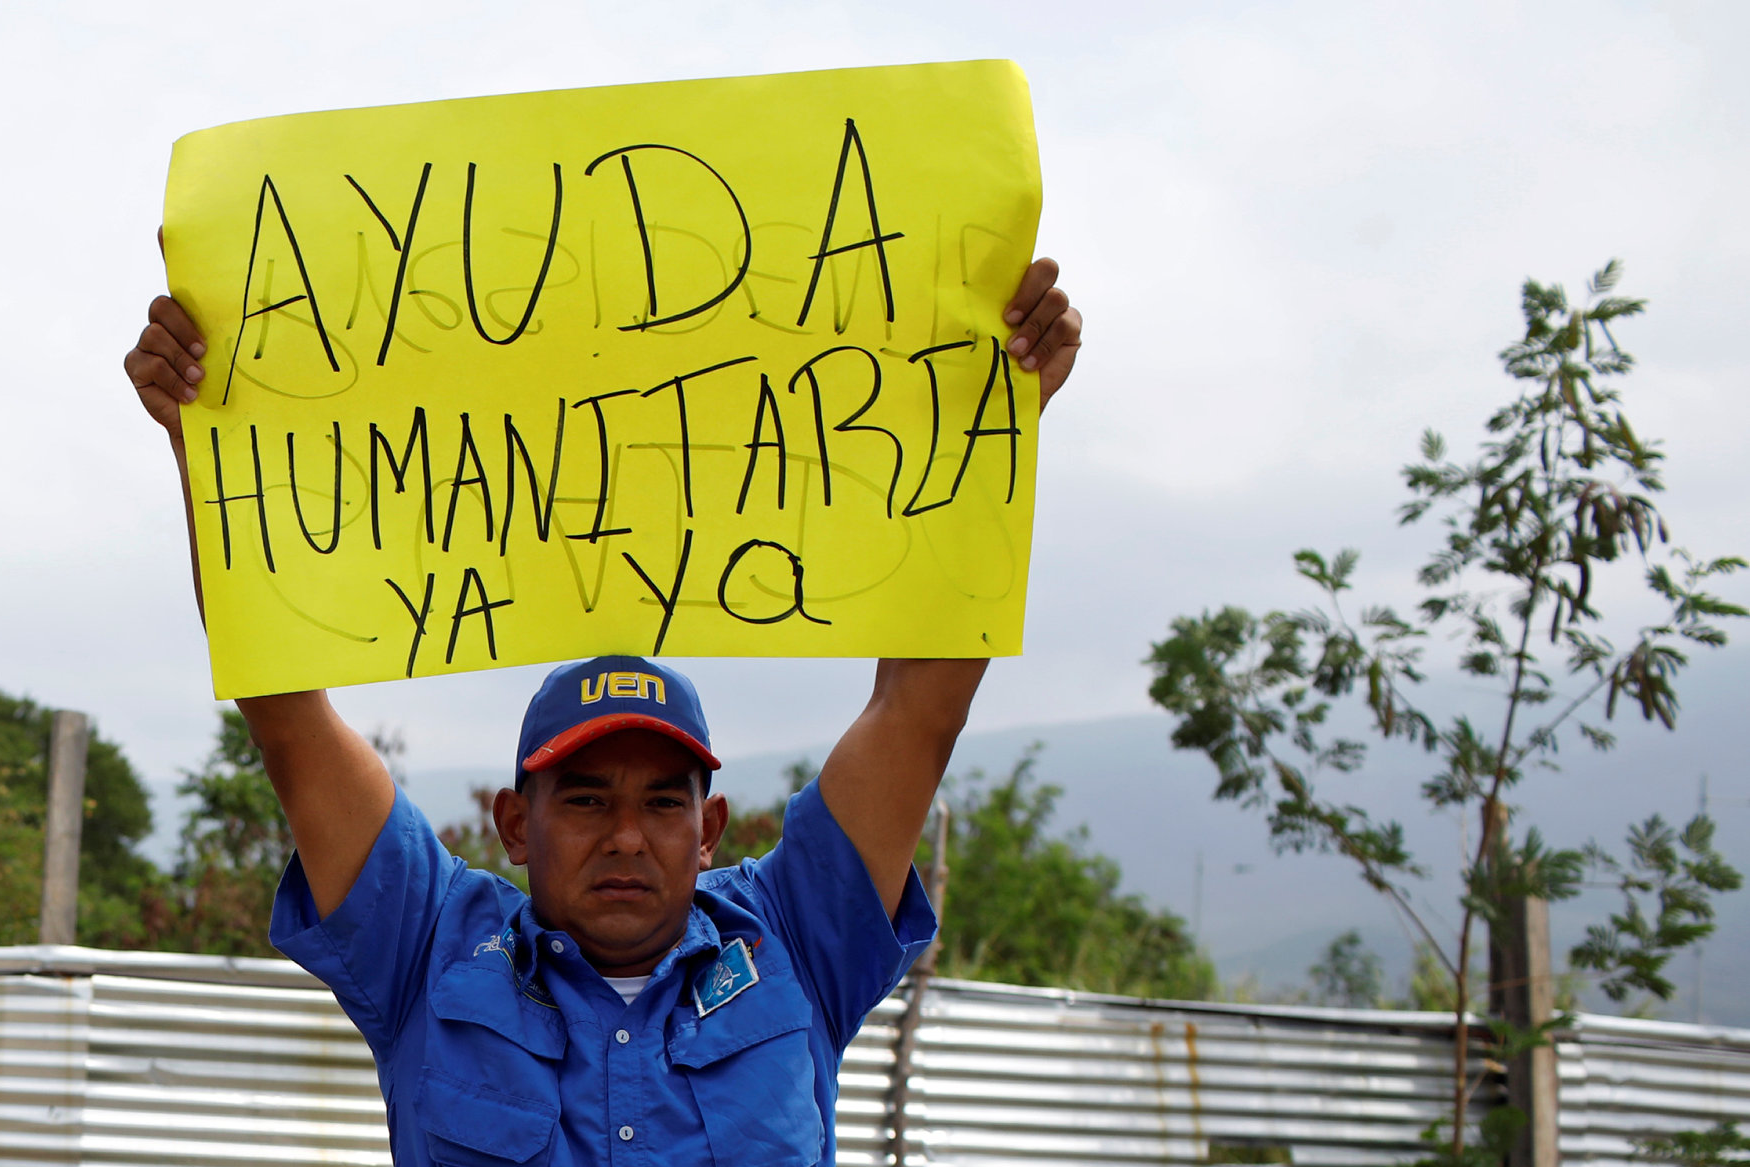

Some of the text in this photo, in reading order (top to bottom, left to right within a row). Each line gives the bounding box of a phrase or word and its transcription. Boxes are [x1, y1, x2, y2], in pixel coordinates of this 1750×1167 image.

[222, 117, 905, 405] AYUDA
[205, 336, 1022, 574] HUMANITARIA
[385, 567, 514, 678] YA
[581, 671, 666, 706] VEN
